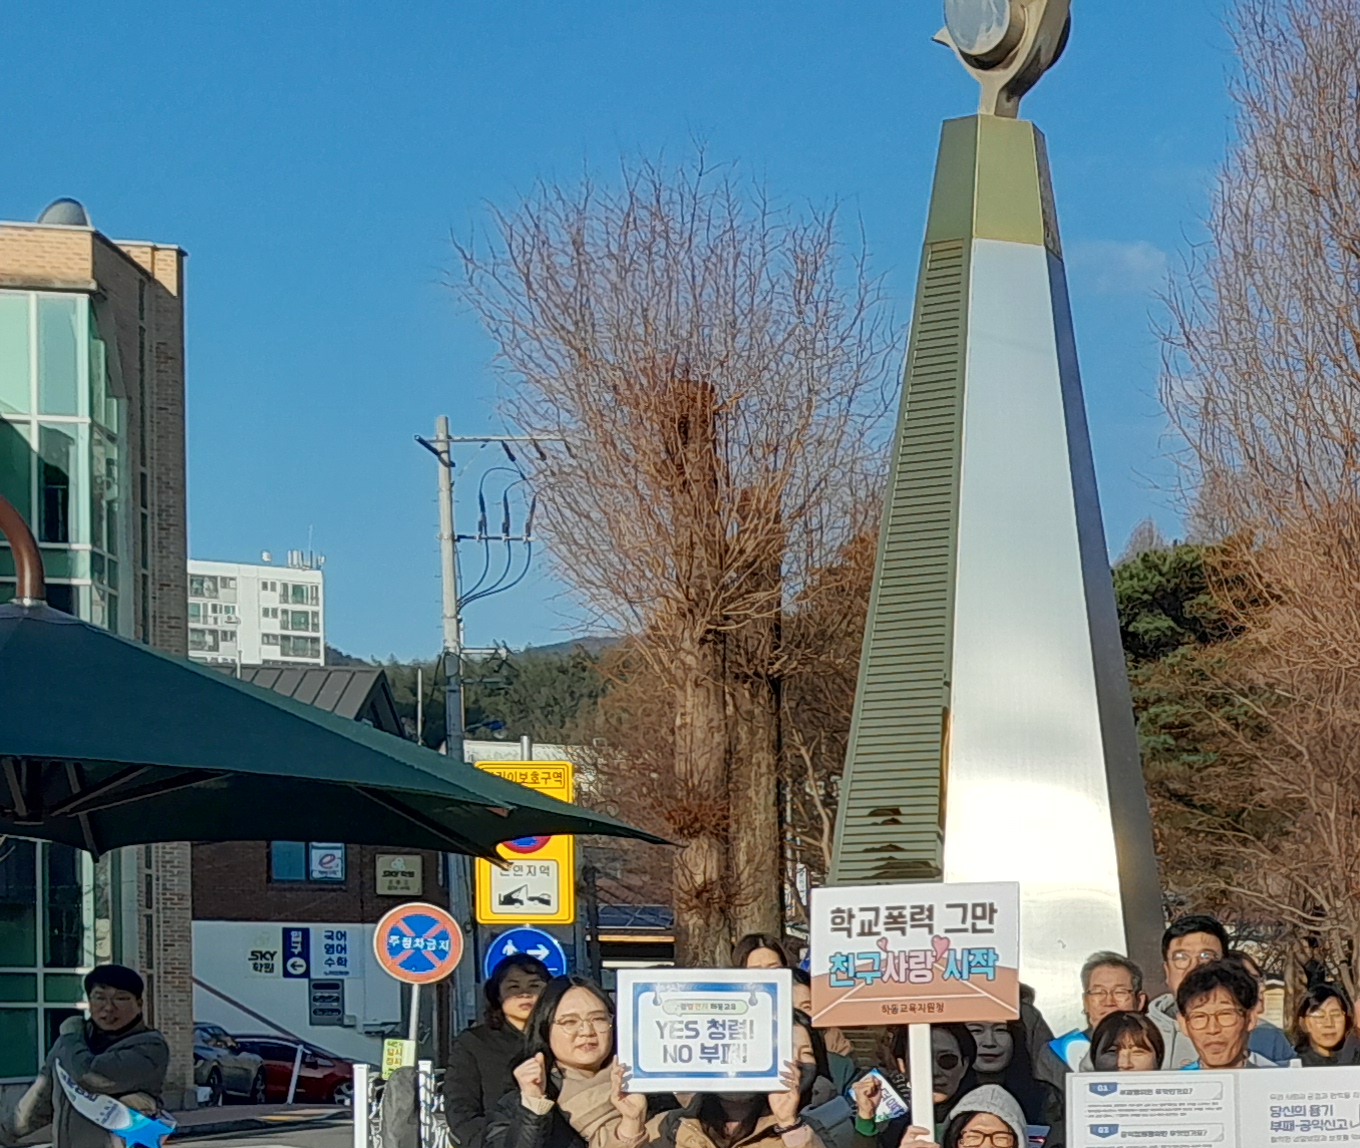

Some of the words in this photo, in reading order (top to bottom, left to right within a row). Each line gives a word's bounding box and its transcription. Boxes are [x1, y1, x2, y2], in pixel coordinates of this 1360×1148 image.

[830, 902, 935, 938] 학교폭력
[943, 902, 998, 934] 그만
[324, 930, 347, 941] 국어
[324, 943, 347, 955] 영어
[388, 934, 450, 951] 주정차금지
[248, 950, 277, 961] SKY
[324, 957, 348, 967] 수학
[252, 962, 275, 973] 학원
[828, 949, 936, 988] 친구사랑
[942, 947, 999, 981] 시작
[881, 1002, 944, 1015] 하동교육지원청
[655, 1020, 700, 1040] YES
[706, 1019, 754, 1040] 청렴!
[663, 1044, 692, 1064] NO
[1270, 1105, 1306, 1118] 당신의
